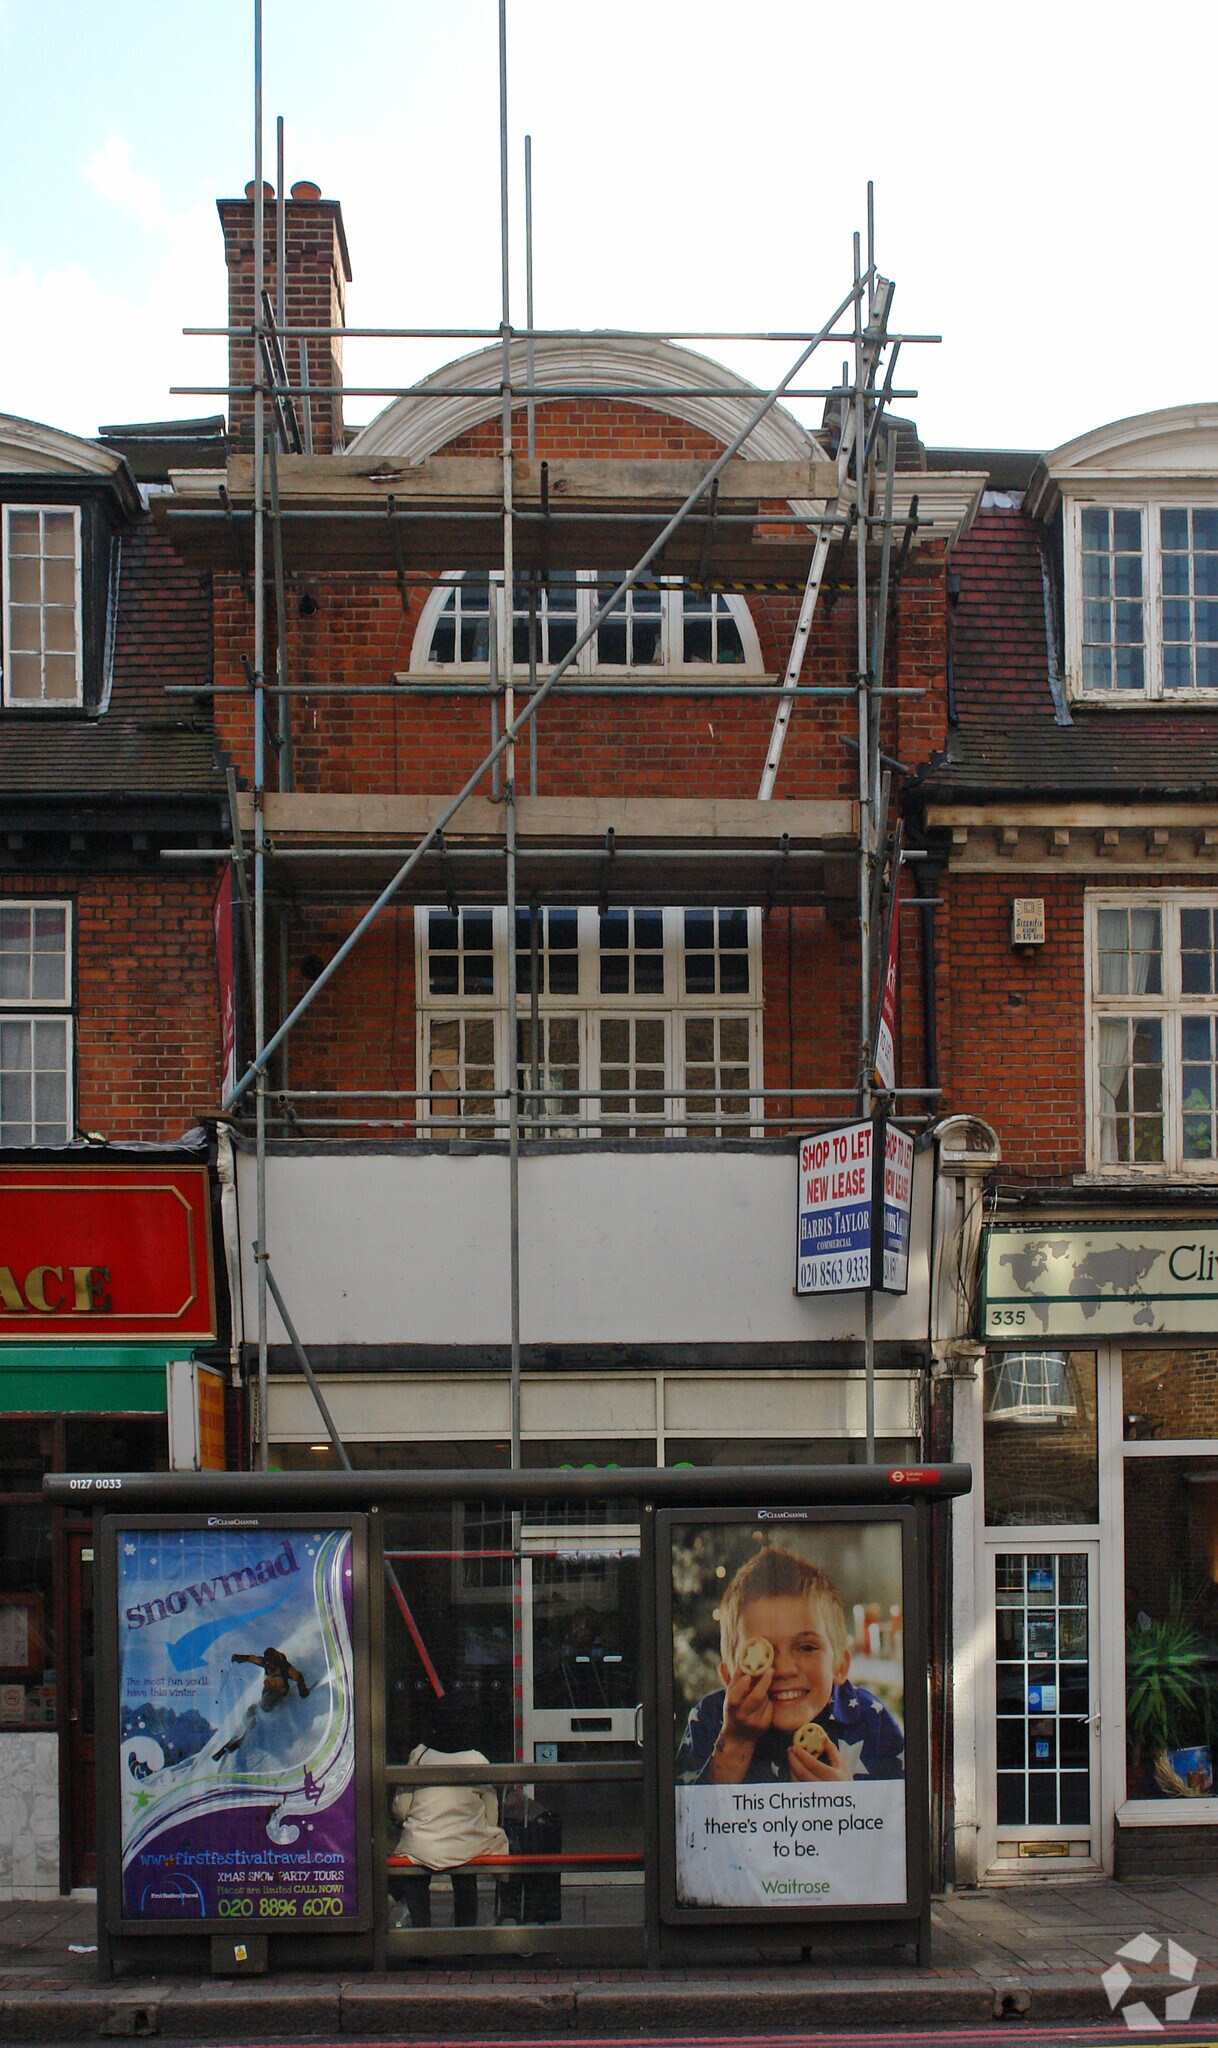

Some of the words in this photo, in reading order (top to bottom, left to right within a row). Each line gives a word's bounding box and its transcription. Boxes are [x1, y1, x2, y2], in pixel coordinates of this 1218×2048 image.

[802, 1140, 830, 1173] SHOP
[833, 1135, 848, 1165] TO
[851, 1129, 872, 1161] LET
[884, 1131, 897, 1163] SHOP
[898, 1138, 904, 1167] TO
[904, 1143, 913, 1172] LET
[806, 1176, 829, 1205] NEW
[832, 1167, 866, 1200] LEASE
[801, 1217, 833, 1240] HARRIS
[834, 1210, 870, 1235] TAYLOR
[816, 1238, 852, 1251] COMMERCIAL
[801, 1262, 818, 1287] 020
[820, 1258, 843, 1286] 8563
[846, 1255, 870, 1283] 9333
[1168, 1244, 1218, 1281] Cli
[991, 1311, 1026, 1325] 335
[69, 1479, 92, 1490] 0127
[95, 1479, 122, 1490] 0033
[126, 1540, 301, 1631] snowmad
[126, 1677, 142, 1686] The
[144, 1677, 165, 1686] most
[168, 1677, 183, 1686] fun
[127, 1688, 148, 1697] have
[150, 1687, 168, 1697] this
[733, 1794, 765, 1810] This
[769, 1792, 856, 1809] Christmas,
[705, 1817, 757, 1834] there's
[762, 1816, 798, 1837] only
[801, 1818, 833, 1831] one
[838, 1814, 884, 1836] place
[773, 1841, 790, 1857] to
[795, 1841, 819, 1857] be.
[217, 1873, 245, 1882] XMAS
[248, 1871, 274, 1881] SNOW
[314, 1870, 344, 1881] TOURS
[216, 1886, 244, 1895] Places
[246, 1886, 261, 1894] are
[263, 1885, 292, 1893] limited
[293, 1885, 317, 1893] CALL
[318, 1884, 344, 1893] NOW!
[761, 1879, 830, 1894] Waitrose
[218, 1898, 253, 1917] 020
[259, 1898, 297, 1917] 8896
[303, 1897, 344, 1916] 6070
